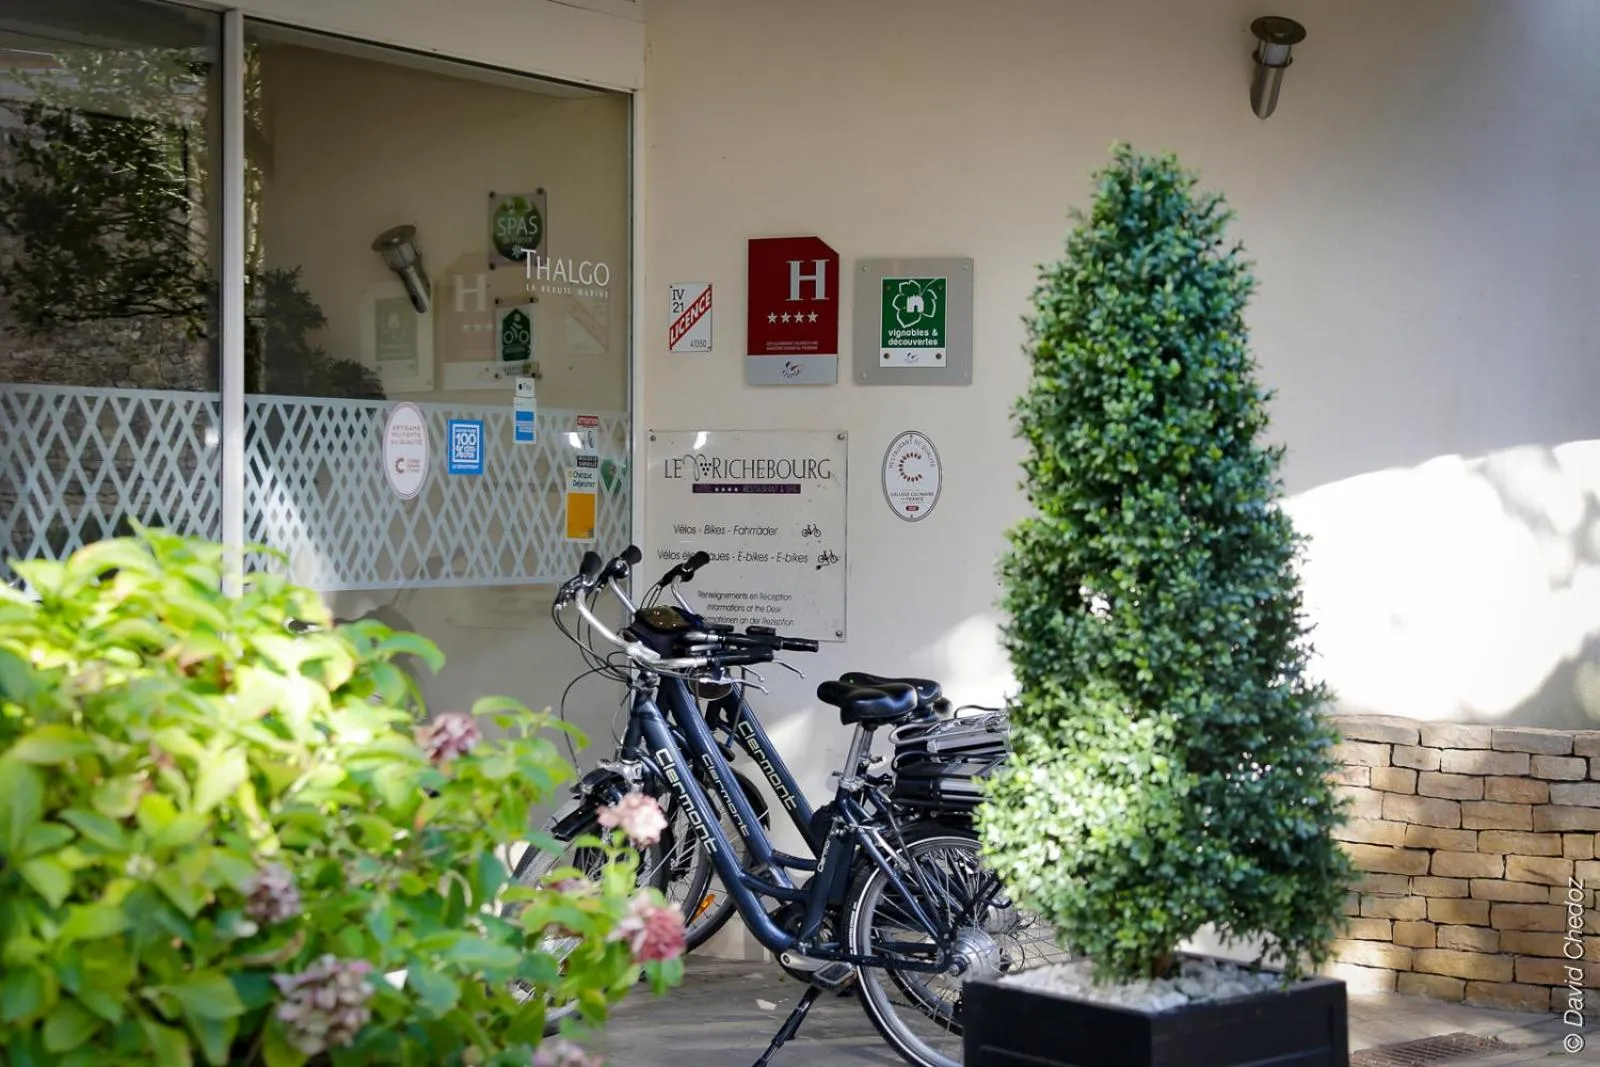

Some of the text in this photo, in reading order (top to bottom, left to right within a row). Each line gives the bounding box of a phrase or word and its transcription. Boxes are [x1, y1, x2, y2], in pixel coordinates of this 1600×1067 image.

[498, 215, 538, 237] SPAS
[520, 247, 610, 287] THALGO
[784, 258, 831, 302] H
[672, 288, 685, 300] IV
[670, 288, 712, 347] LICENCE
[672, 301, 685, 313] 21
[887, 338, 938, 346] découvertes
[888, 328, 938, 338] vignobles &
[455, 432, 477, 446] 100
[663, 457, 831, 480] LE RICHEBOURG
[673, 524, 697, 535] Vélos
[703, 524, 725, 535] Bikes
[733, 525, 778, 536] Fahrräder
[657, 550, 681, 560] Vélos
[737, 553, 769, 563] E-bikes
[776, 553, 809, 563] E-bikes
[737, 720, 797, 811] Clermont
[655, 747, 718, 855] Clermont
[701, 753, 750, 838] Clermont
